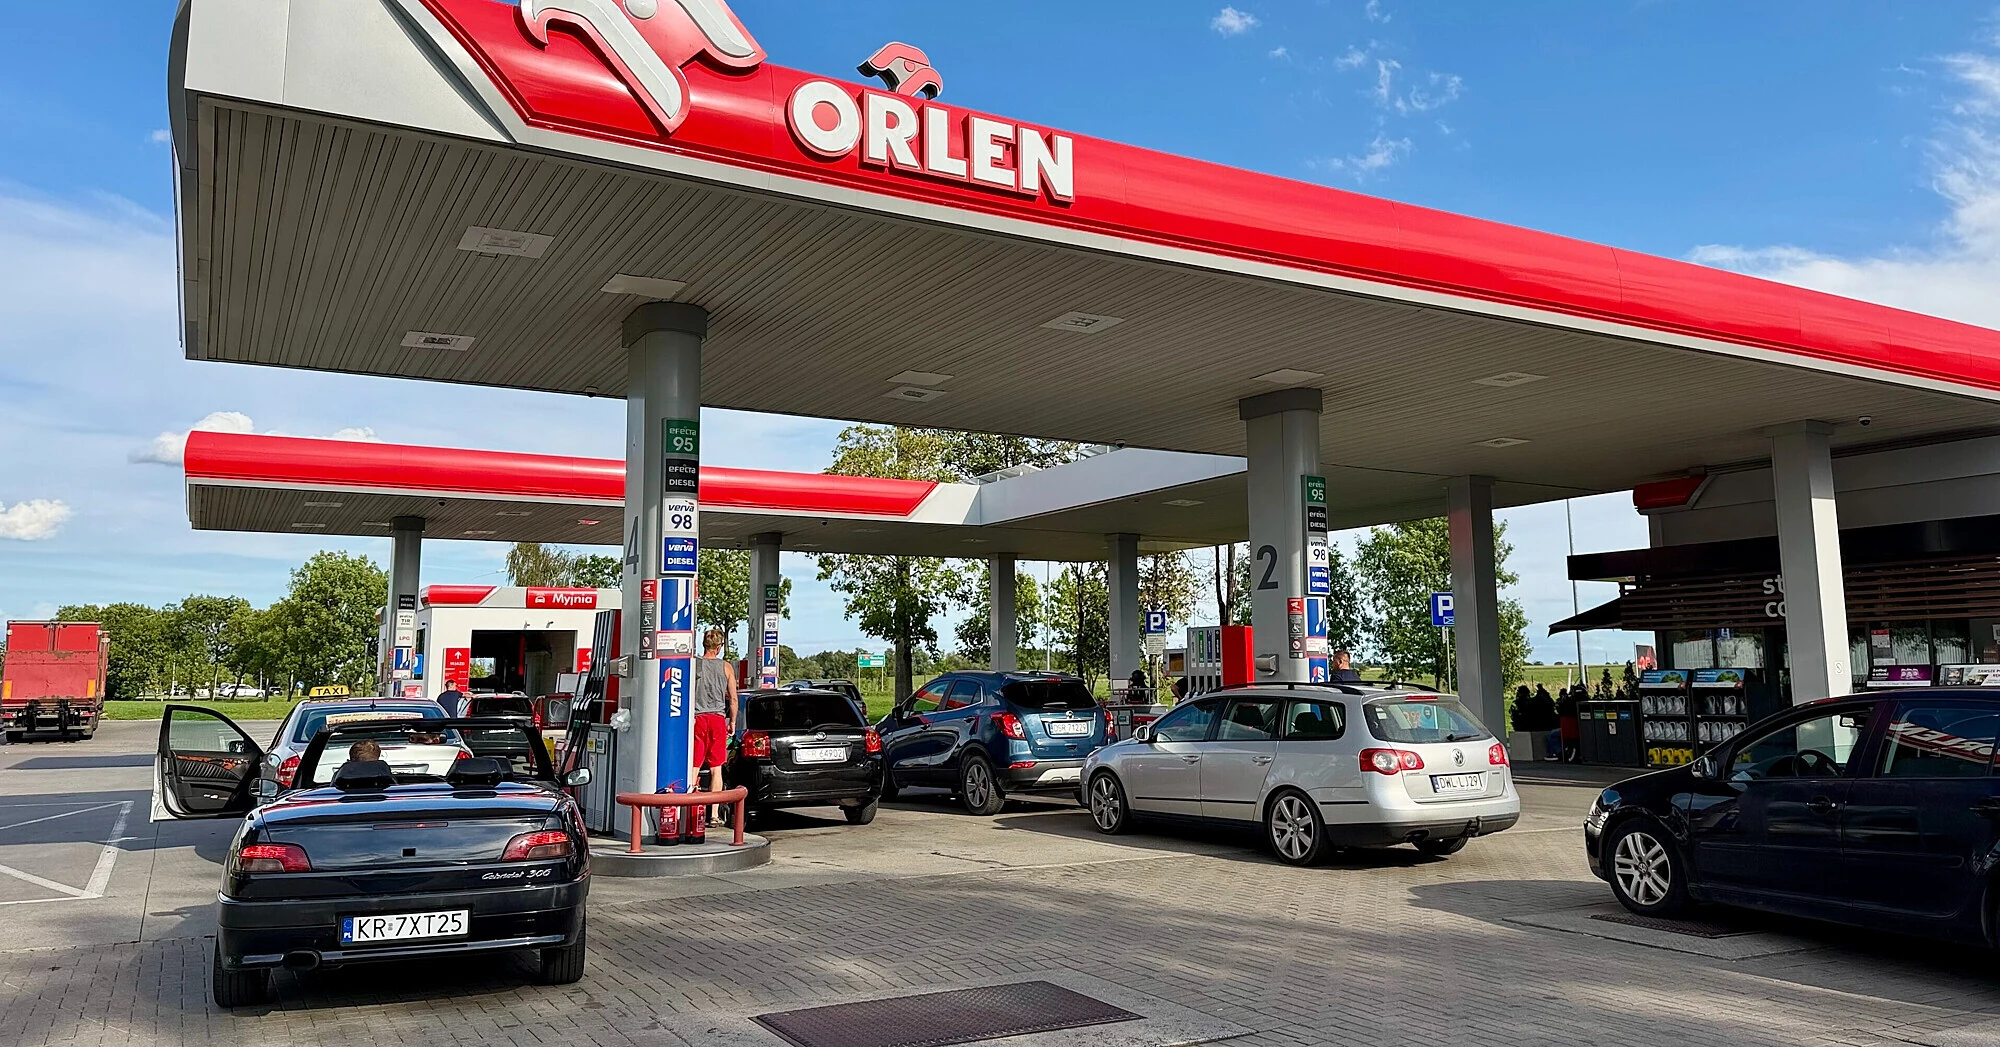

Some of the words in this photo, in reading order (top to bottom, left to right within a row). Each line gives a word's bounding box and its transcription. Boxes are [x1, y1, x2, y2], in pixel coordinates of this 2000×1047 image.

[788, 79, 1076, 202] ORLEN
[669, 427, 697, 436] efecta
[673, 436, 694, 452] 95
[668, 465, 696, 474] efecta
[669, 478, 695, 487] DIESEL
[1311, 489, 1325, 501] 95
[668, 504, 695, 512] verva
[671, 513, 692, 530] 98
[625, 515, 640, 575] 4
[668, 544, 694, 552] verva
[1313, 548, 1326, 561] 98
[667, 557, 695, 566] DIESEL
[1256, 544, 1279, 591] 2
[552, 592, 592, 606] Myjnia
[1437, 595, 1454, 617] P
[767, 621, 777, 629] 98
[1150, 613, 1162, 631] P
[316, 687, 344, 696] TAXI
[670, 667, 682, 717] verva
[1439, 776, 1458, 788] DWL
[358, 918, 387, 939] KR
[395, 913, 462, 937] 7XT25
